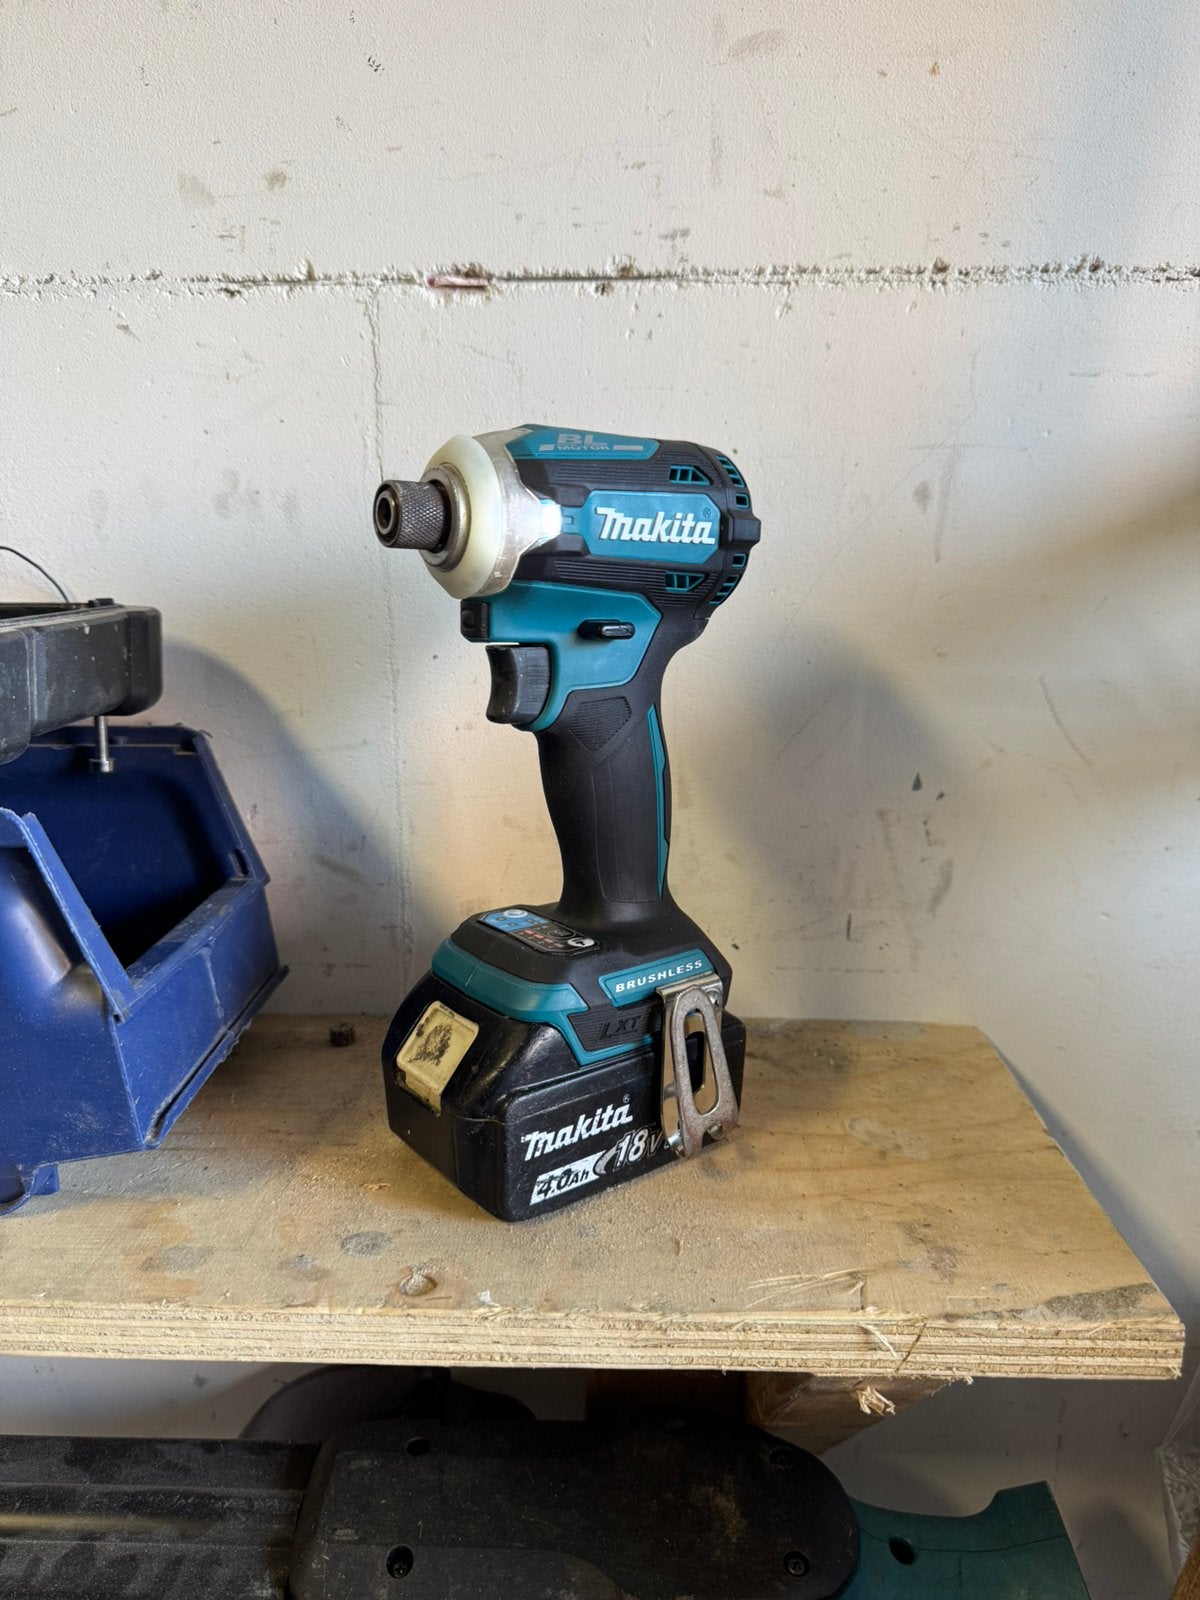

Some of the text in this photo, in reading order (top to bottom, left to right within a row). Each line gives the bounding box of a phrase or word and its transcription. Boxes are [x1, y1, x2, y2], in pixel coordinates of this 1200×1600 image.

[557, 433, 608, 446] BL
[596, 506, 716, 545] Makita
[615, 959, 703, 993] BRUSHLESS
[600, 1014, 642, 1039] LXT
[521, 1103, 633, 1162] Makita
